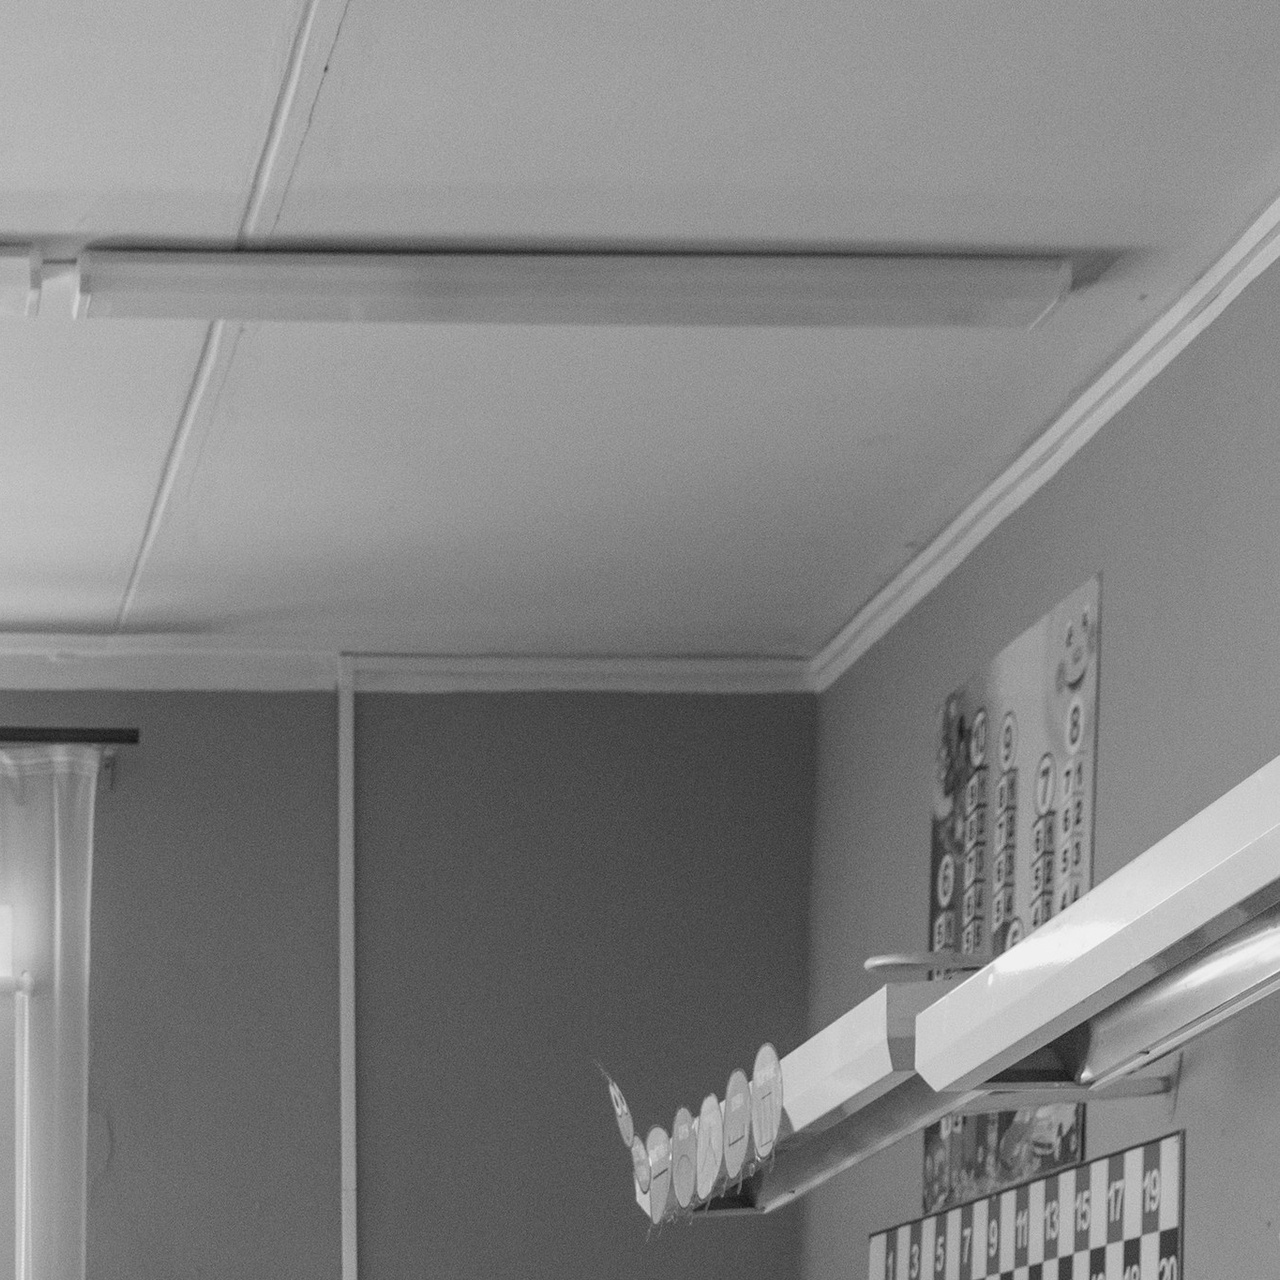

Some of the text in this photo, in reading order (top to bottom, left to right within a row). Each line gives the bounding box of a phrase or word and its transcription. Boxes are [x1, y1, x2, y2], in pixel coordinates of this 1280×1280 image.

[1070, 705, 1081, 746] 8
[1041, 765, 1051, 799] 7
[910, 1243, 919, 1279] 3
[935, 1235, 945, 1271] 5
[962, 1227, 971, 1264] 7
[988, 1219, 998, 1257] 9
[1016, 1211, 1029, 1250] 11
[1045, 1202, 1059, 1241] 13
[1075, 1190, 1090, 1232] 15
[1107, 1180, 1125, 1223] 17
[1143, 1168, 1161, 1213] 19
